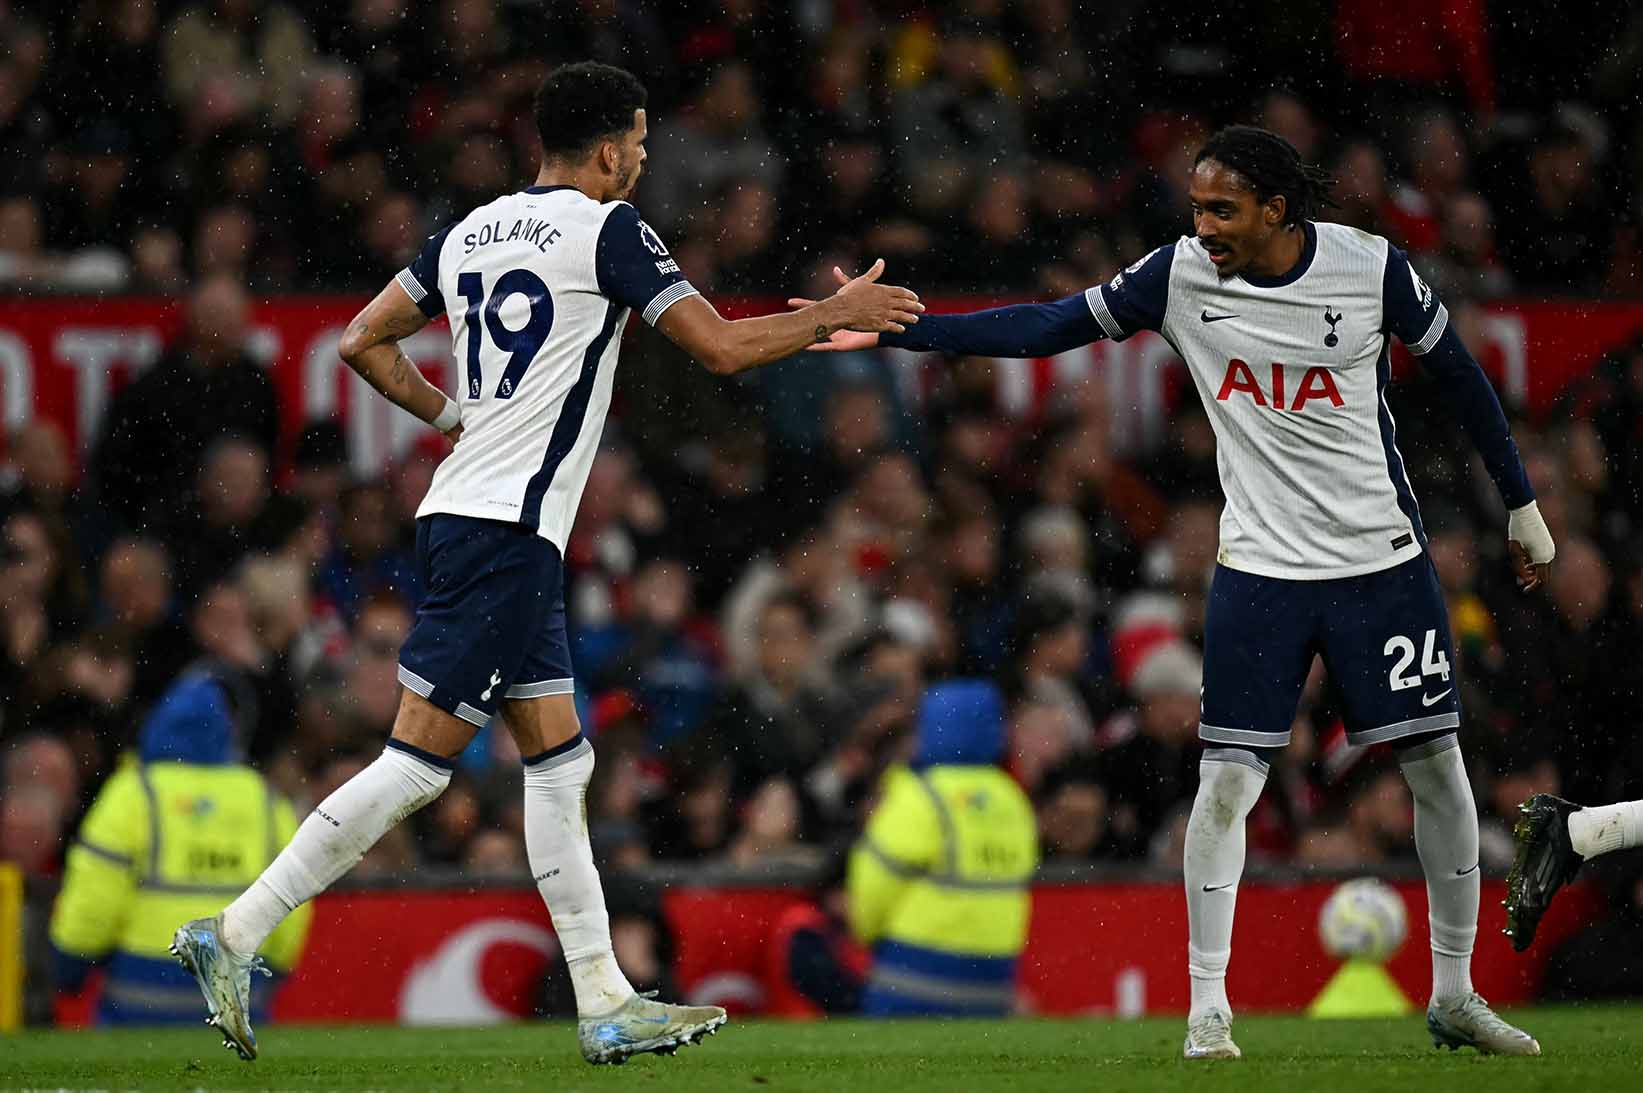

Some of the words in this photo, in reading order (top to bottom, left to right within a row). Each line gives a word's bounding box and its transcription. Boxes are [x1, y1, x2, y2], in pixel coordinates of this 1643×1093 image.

[464, 218, 562, 254] SOLANKE
[457, 268, 554, 400] 19
[1216, 358, 1345, 411] AIA
[1383, 629, 1450, 691] 24
